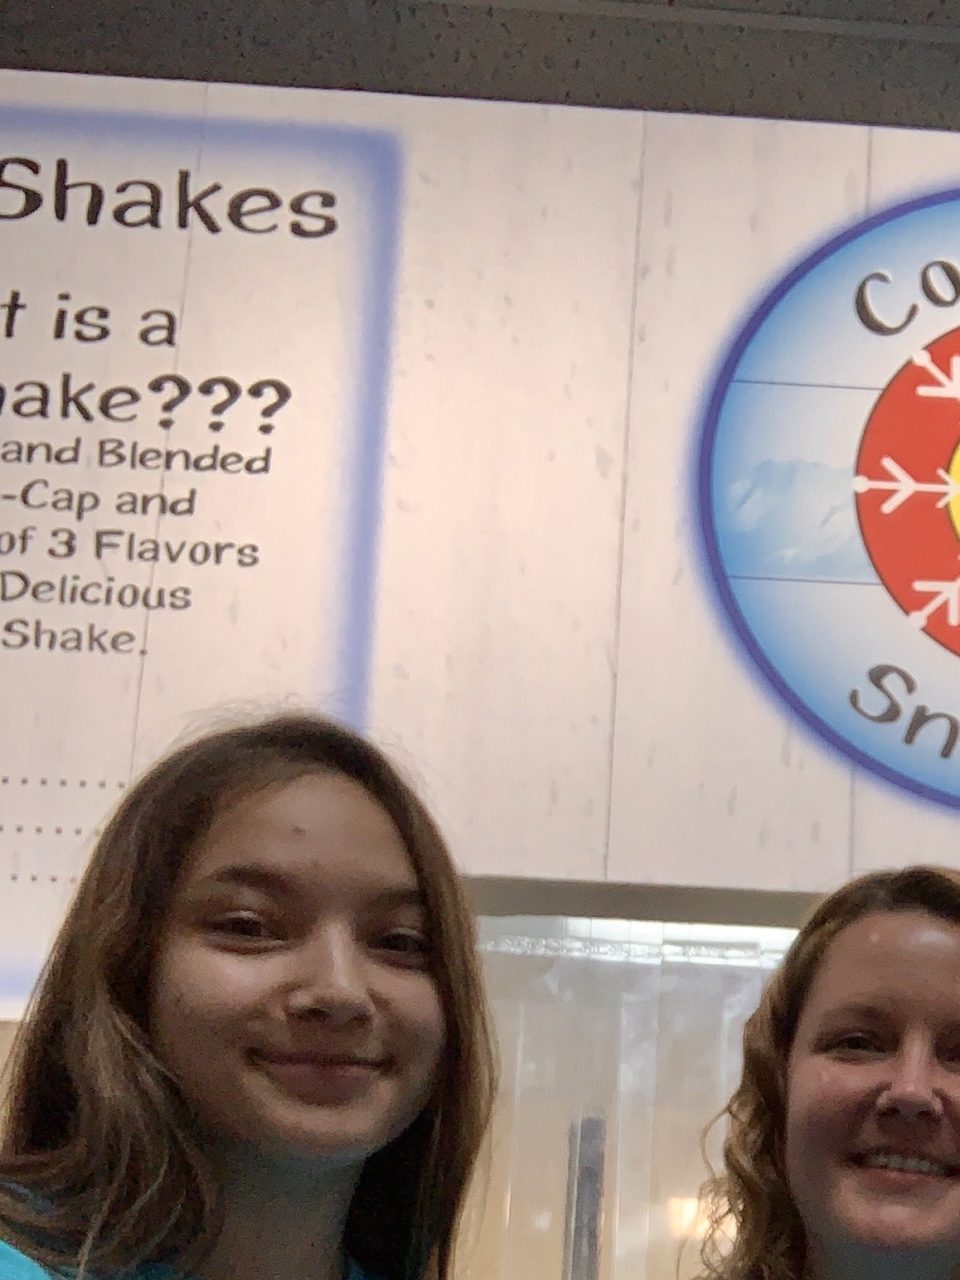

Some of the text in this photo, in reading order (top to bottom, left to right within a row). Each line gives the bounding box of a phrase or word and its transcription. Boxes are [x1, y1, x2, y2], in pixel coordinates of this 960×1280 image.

[0, 156, 339, 239] Shakes
[53, 292, 112, 344] is
[140, 308, 178, 347] a
[0, 371, 292, 435] ake???
[1, 436, 272, 475] and Blended
[1, 478, 197, 521] -Cap and
[0, 525, 260, 568] of 3 Flavors
[0, 569, 193, 611] Delicious
[1, 617, 149, 657] Shake.
